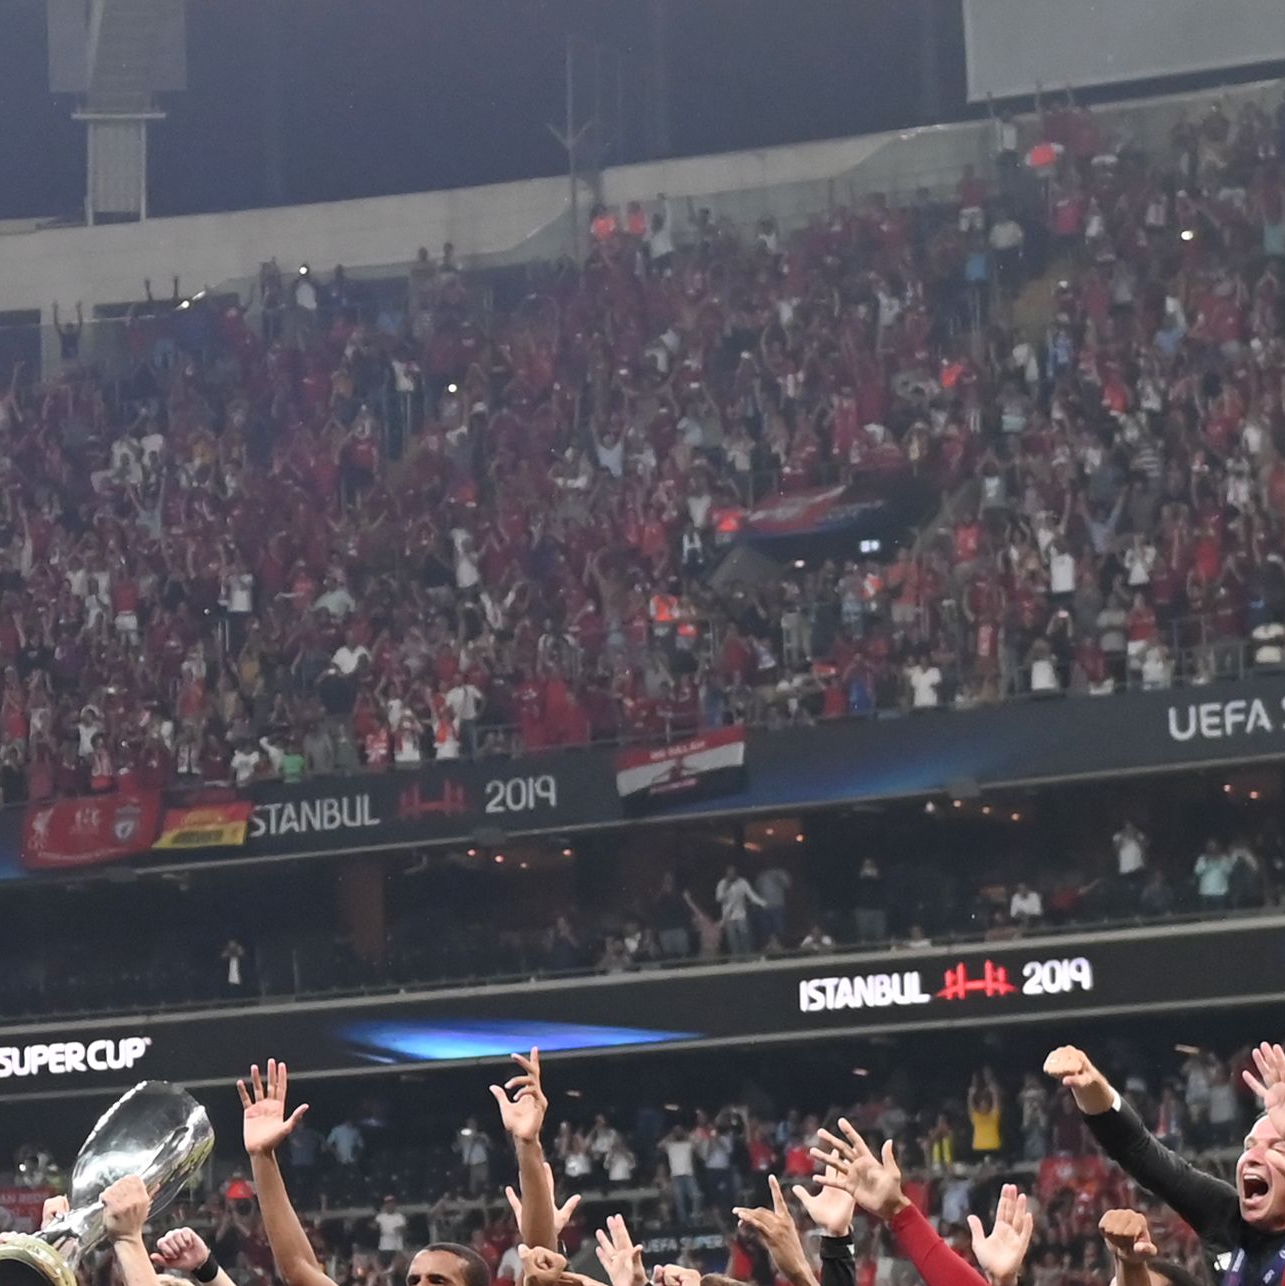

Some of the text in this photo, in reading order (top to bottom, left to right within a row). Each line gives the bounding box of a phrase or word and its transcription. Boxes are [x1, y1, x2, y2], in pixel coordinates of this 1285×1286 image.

[1168, 698, 1273, 741] UEFA
[249, 794, 381, 838] STANBUL
[484, 775, 557, 814] 2019
[799, 957, 1094, 1012] ISTANBUL 2019
